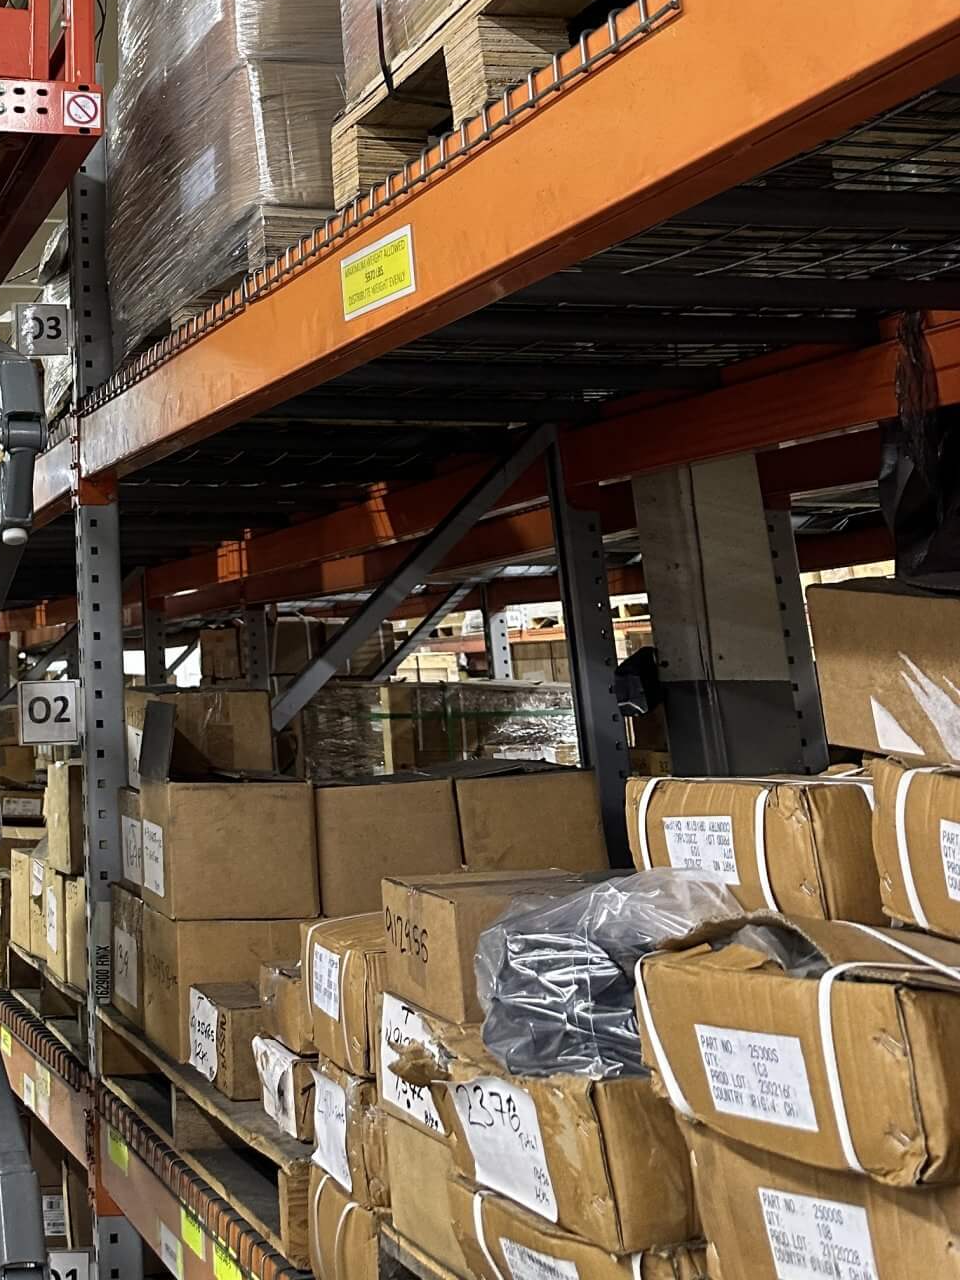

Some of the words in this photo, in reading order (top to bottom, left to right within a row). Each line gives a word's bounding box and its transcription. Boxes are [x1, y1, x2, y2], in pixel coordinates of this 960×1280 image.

[700, 1034, 719, 1051] PART
[712, 1085, 744, 1105] COUNTRY
[762, 1192, 781, 1209] PART
[774, 1246, 808, 1269] COUNTRY
